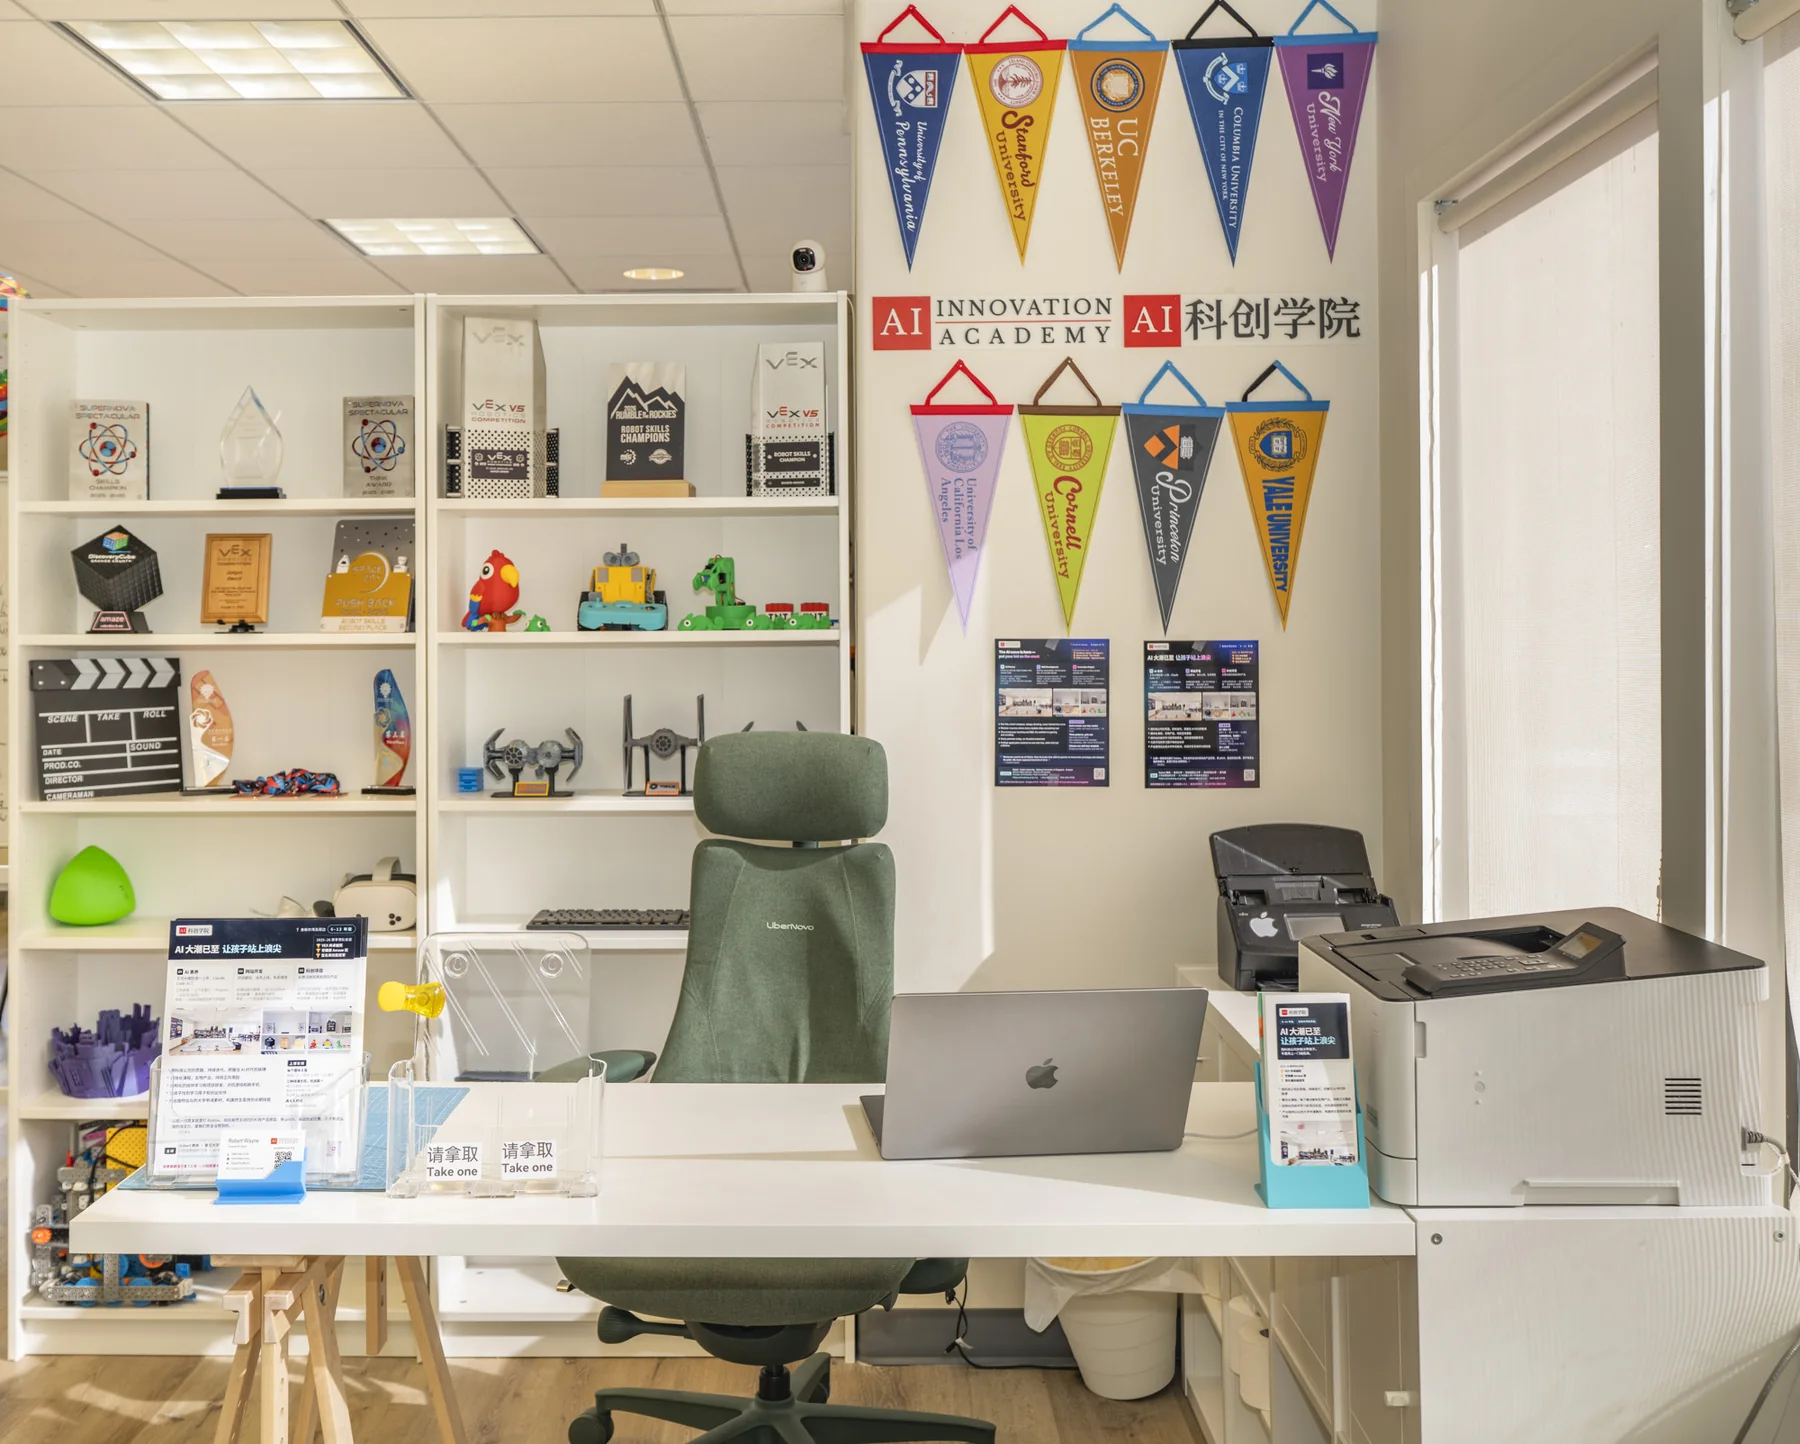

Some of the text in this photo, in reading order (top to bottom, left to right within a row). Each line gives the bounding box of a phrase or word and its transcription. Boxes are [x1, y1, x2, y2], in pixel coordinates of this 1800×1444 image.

[1218, 110, 1224, 118] IN
[1117, 118, 1138, 156] UC
[1318, 91, 1342, 172] New York
[1001, 110, 1036, 187] Stanford
[1306, 102, 1327, 182] University
[913, 121, 928, 182] University of
[1220, 152, 1226, 163] OF
[1090, 117, 1124, 216] BERKELEY
[1228, 107, 1244, 228] COLUMBIA UNIVERSITY
[895, 121, 918, 232] Pennsylvania
[996, 130, 1026, 221] University
[936, 298, 1112, 316] INNOVATION
[880, 308, 923, 335] AI
[1131, 296, 1361, 340] AI 科创学院
[939, 326, 1110, 345] ACADEMY
[765, 352, 818, 369] VEX
[472, 399, 506, 411] VEX
[767, 406, 800, 418] VEX
[616, 411, 642, 419] RUMBLE
[650, 410, 676, 418] ROCKIES
[620, 433, 670, 443] CHAMPIONS
[939, 478, 952, 523] Angeles
[954, 478, 964, 559] California Los
[964, 478, 978, 552] University of
[1054, 476, 1082, 550] Cornell
[1156, 471, 1192, 563] Princeton
[1151, 485, 1166, 565] University
[1044, 491, 1069, 579] University
[1262, 476, 1295, 592] YALE UNIVERSITY
[218, 544, 252, 557] VEX
[335, 598, 396, 607] PUSH BACK
[48, 715, 78, 723] SCENE
[97, 712, 120, 721] TAKE
[130, 742, 161, 751] SOUND
[44, 761, 82, 770] PROD.CO.
[45, 775, 84, 785] DIRECTOR
[46, 791, 94, 801] CAMERAMAN
[174, 944, 282, 954] AI 大潮已至 让孩子站上浪尖
[1289, 1027, 1321, 1035] 大潮已至
[1281, 1036, 1336, 1045] 让孩子站上浪尖
[428, 1146, 478, 1163] 请拿取
[503, 1142, 553, 1159] 请拿取
[426, 1167, 478, 1177] Take one
[502, 1163, 553, 1173] Take one
